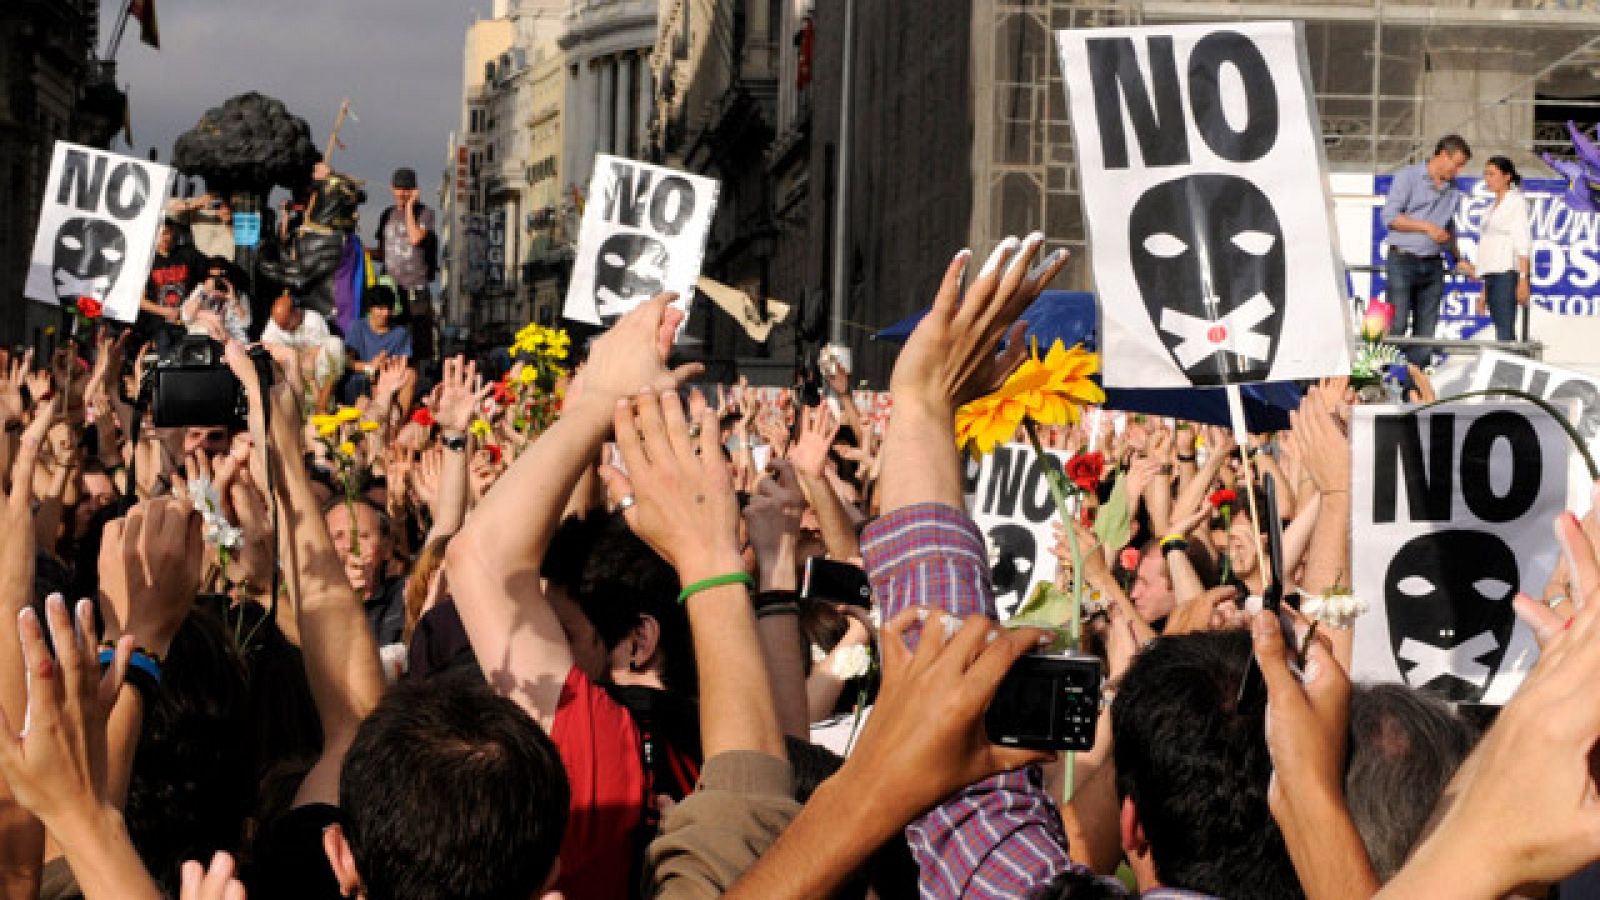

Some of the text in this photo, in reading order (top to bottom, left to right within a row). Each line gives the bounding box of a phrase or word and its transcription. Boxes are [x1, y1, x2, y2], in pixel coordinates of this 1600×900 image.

[1085, 30, 1280, 170] NO
[57, 150, 150, 220] NO
[604, 162, 696, 236] NO
[982, 444, 1062, 522] NO
[1373, 410, 1543, 523] NO
